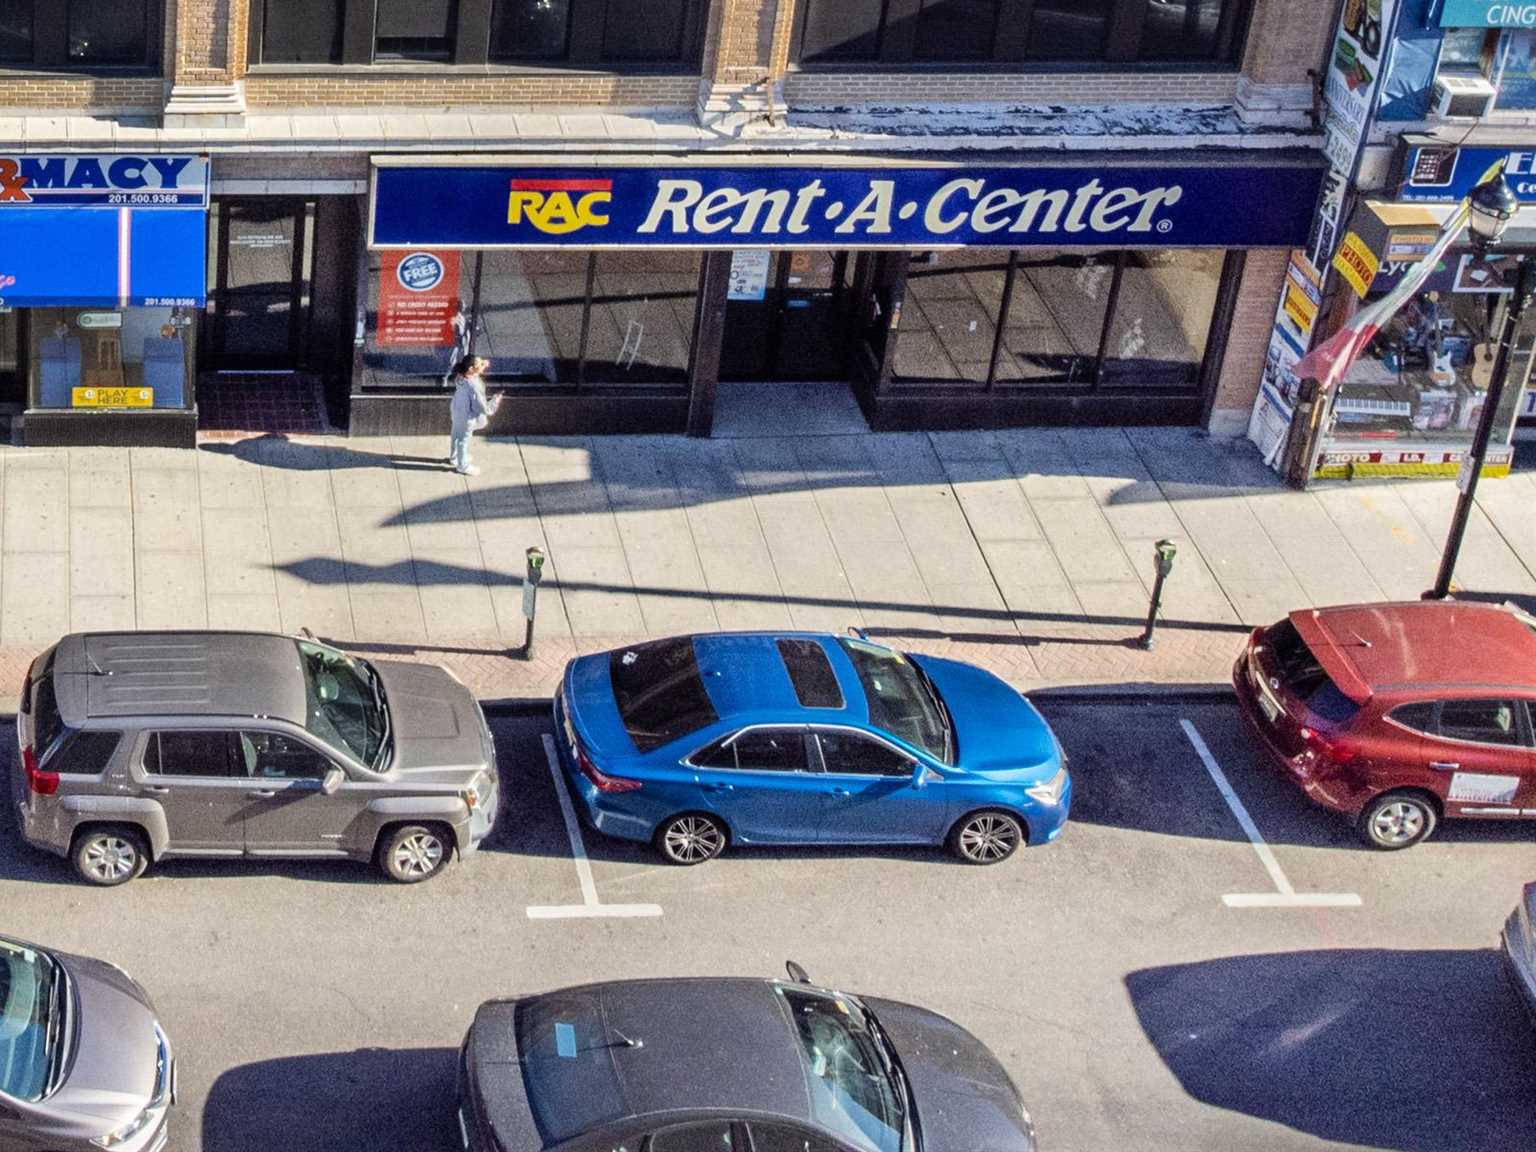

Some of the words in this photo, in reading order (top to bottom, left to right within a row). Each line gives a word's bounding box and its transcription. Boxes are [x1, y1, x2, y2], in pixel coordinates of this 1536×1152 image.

[109, 194, 178, 204] 201.500.9366
[507, 190, 612, 235] RAC
[402, 261, 439, 282] FREE
[97, 389, 128, 397] PLAY
